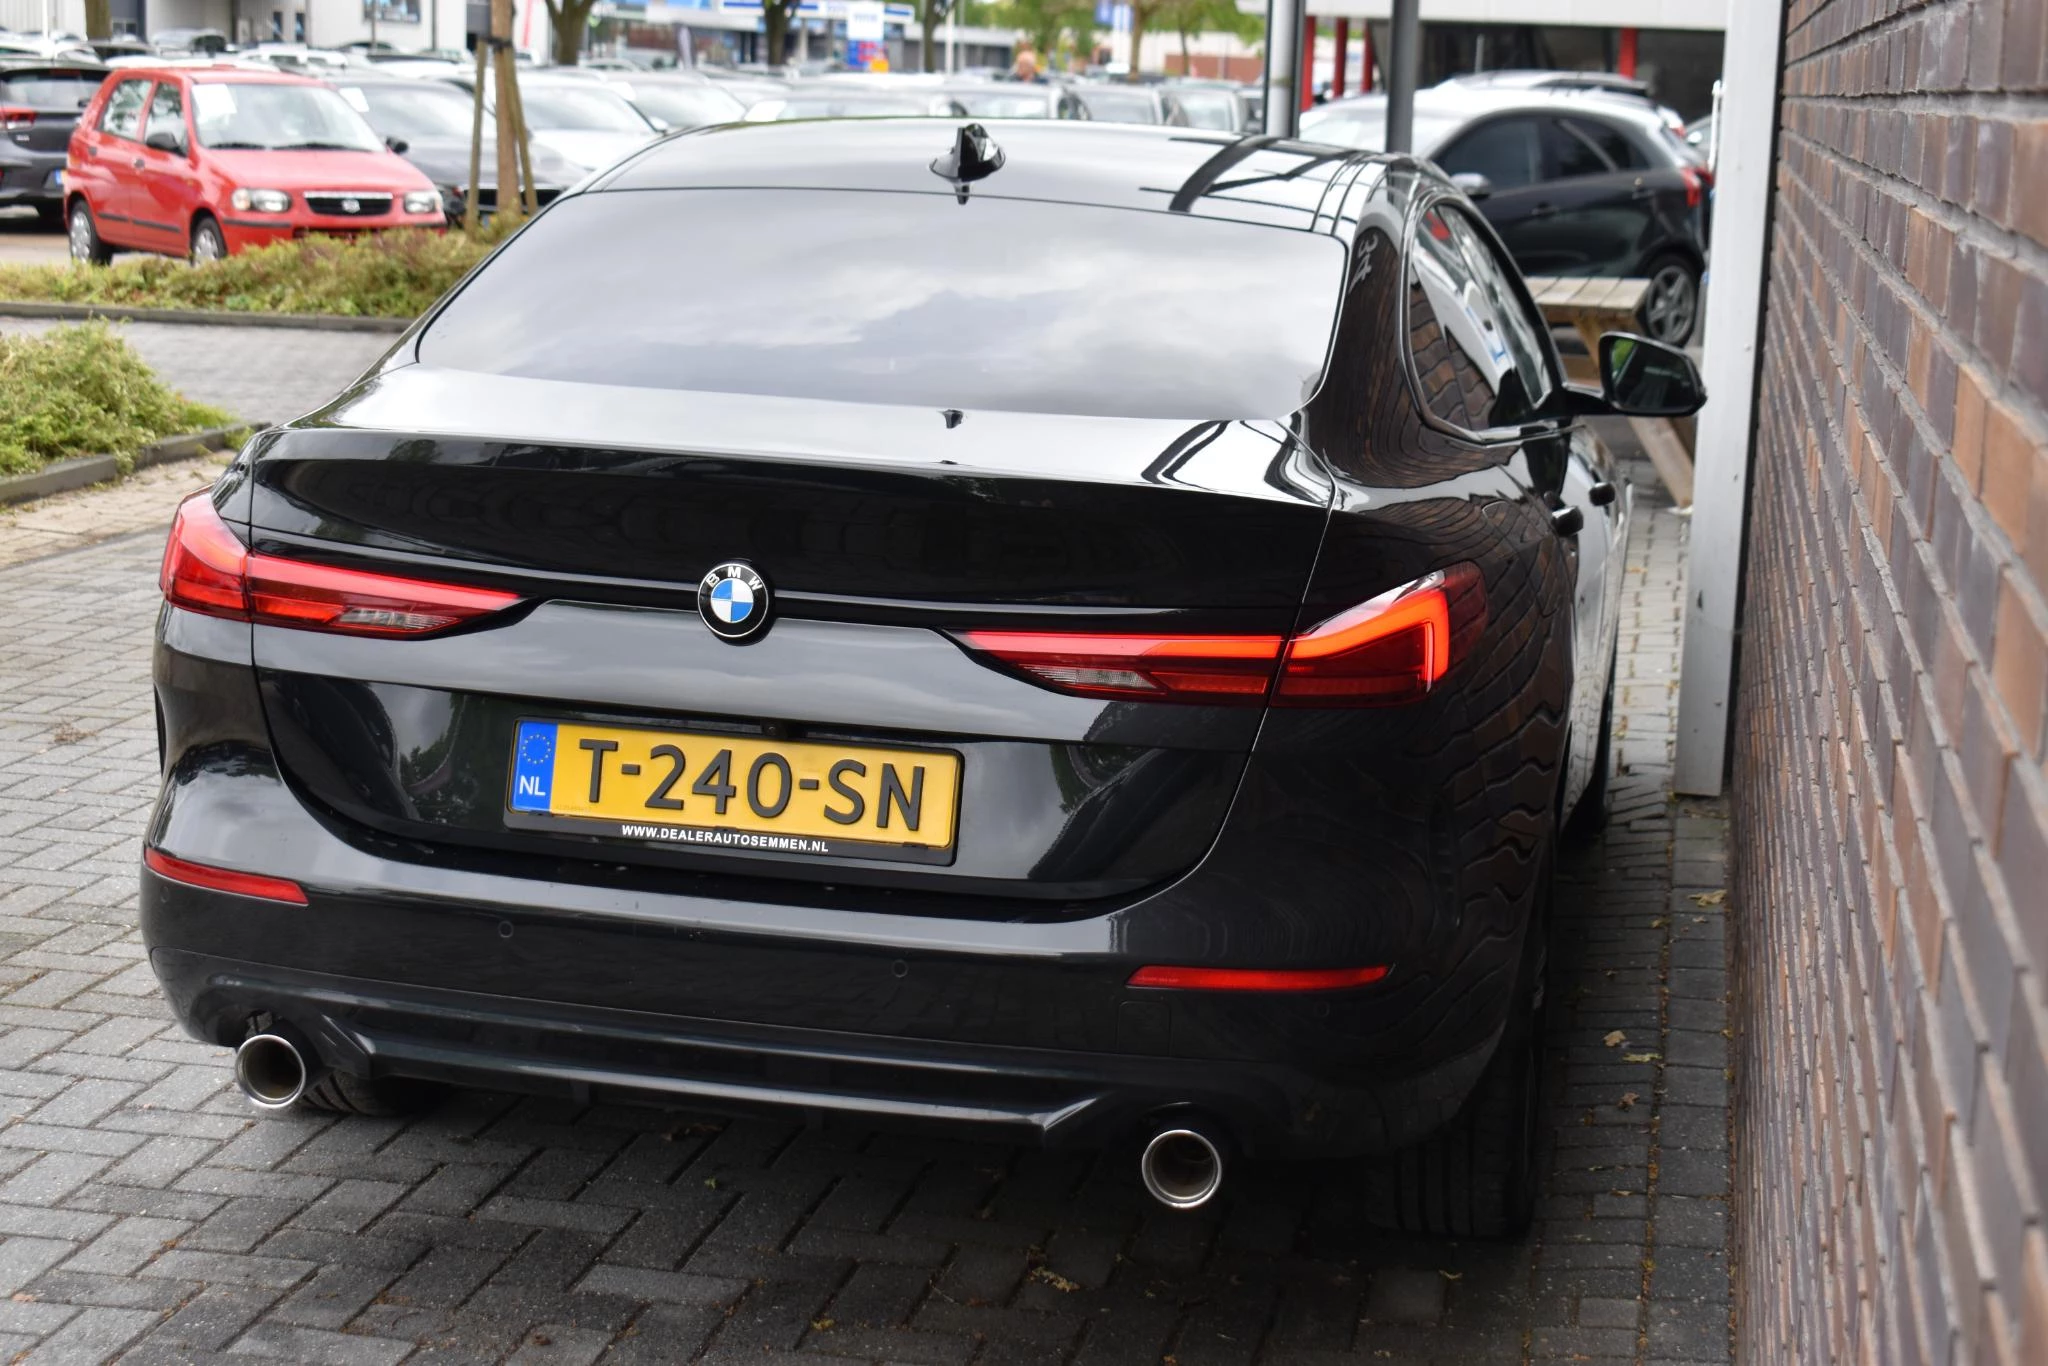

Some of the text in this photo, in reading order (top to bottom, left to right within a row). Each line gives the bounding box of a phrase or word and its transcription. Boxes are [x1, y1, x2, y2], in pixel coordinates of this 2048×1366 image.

[705, 565, 763, 591] BMW
[519, 774, 546, 796] NL
[578, 738, 926, 831] T-240-SN
[621, 825, 829, 852] WWW.DEALERAUTOSEMMEN.NL
